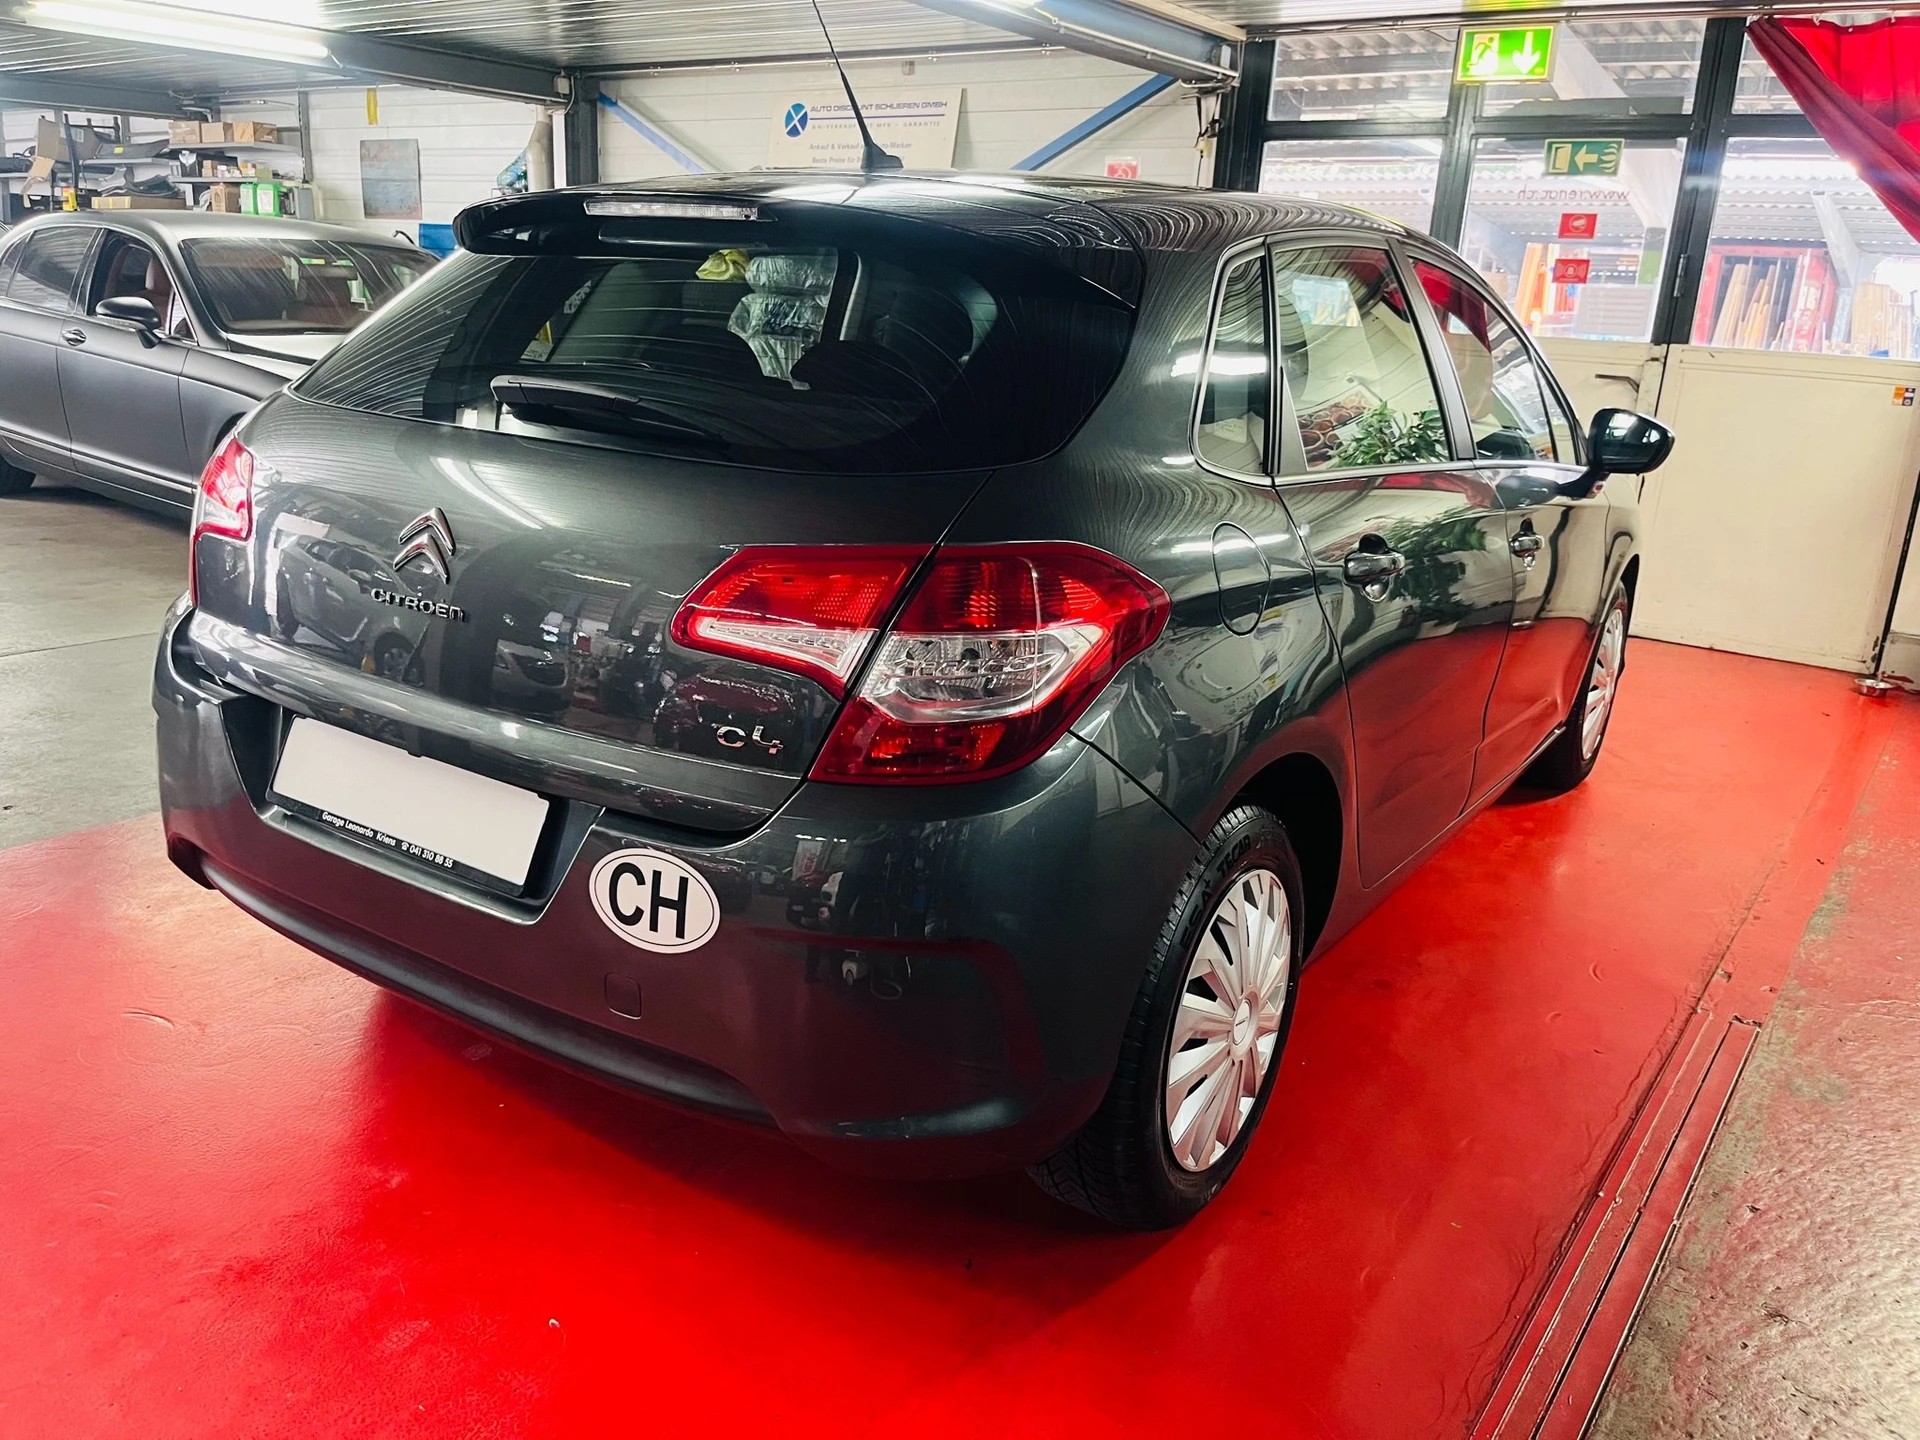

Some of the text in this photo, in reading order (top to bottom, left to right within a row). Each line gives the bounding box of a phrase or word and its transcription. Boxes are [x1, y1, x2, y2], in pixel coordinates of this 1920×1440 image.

[833, 103, 873, 112] DISCUNT
[875, 102, 920, 110] SCHLIEREN
[921, 101, 948, 109] GMBH
[902, 120, 940, 128] GARANTIE
[716, 725, 784, 755] C4
[322, 811, 454, 868] Garage Leonardo Kriens 041 310 88 55
[608, 861, 689, 940] CH
